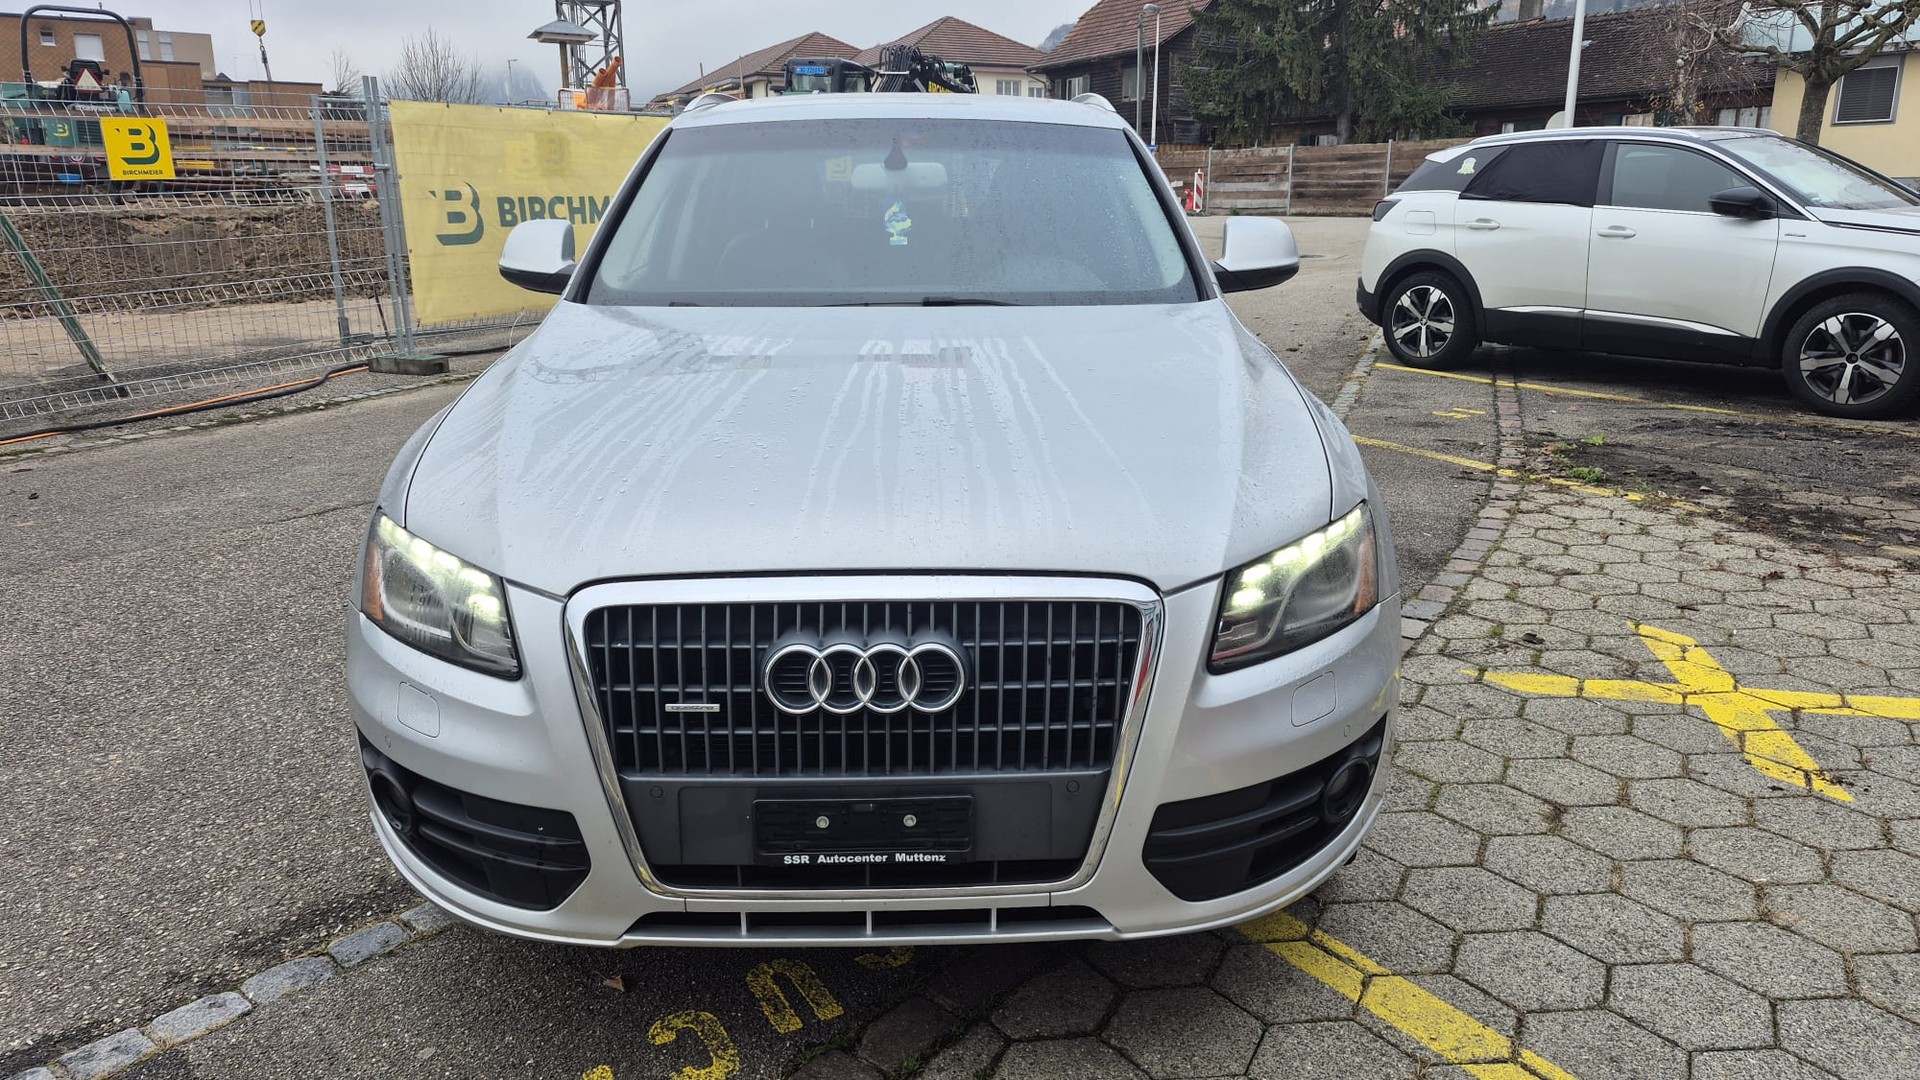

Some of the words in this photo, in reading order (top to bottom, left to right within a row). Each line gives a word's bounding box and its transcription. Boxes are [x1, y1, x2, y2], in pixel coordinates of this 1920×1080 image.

[496, 194, 614, 227] BIRCHM
[783, 855, 810, 865] SSR
[817, 853, 889, 864] Autocenter
[895, 852, 946, 862] Muttenz
